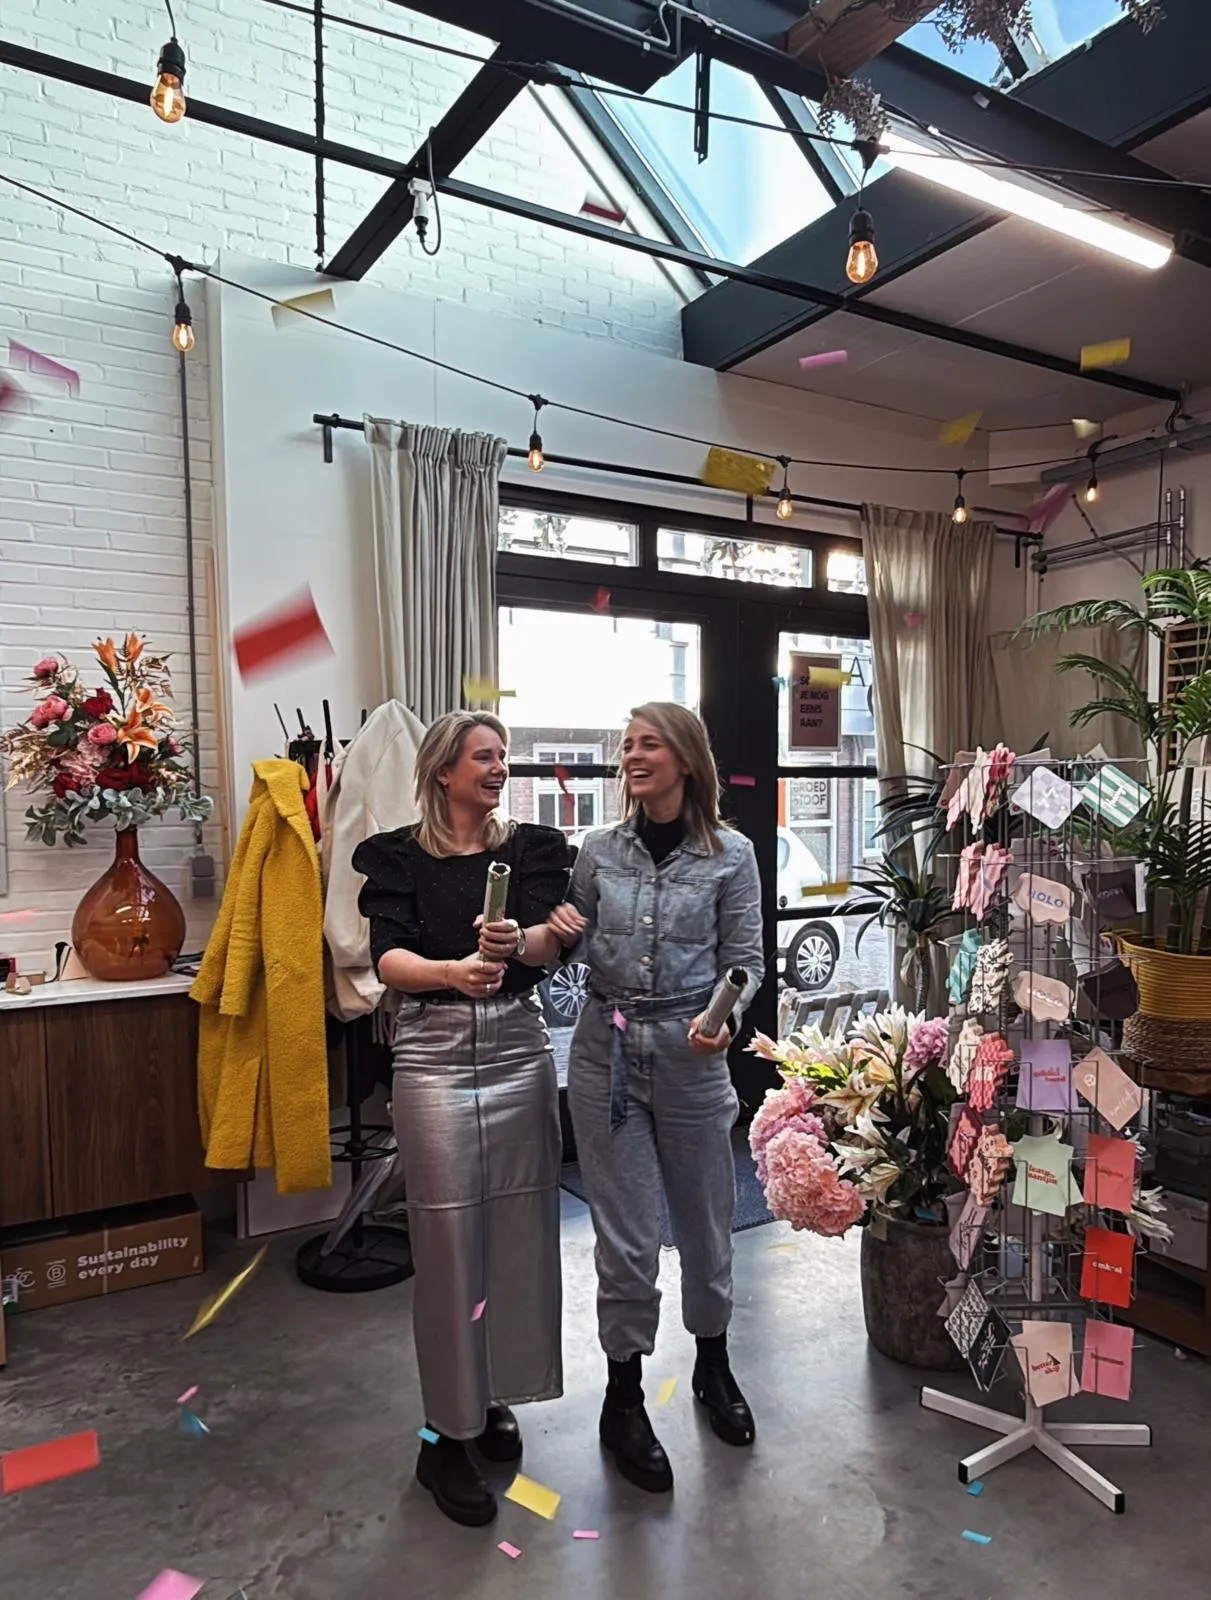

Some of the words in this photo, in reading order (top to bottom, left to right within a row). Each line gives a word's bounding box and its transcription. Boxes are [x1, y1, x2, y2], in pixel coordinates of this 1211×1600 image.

[77, 1236, 189, 1267] Sustainability
[78, 1263, 124, 1280] every
[130, 1254, 159, 1269] day
